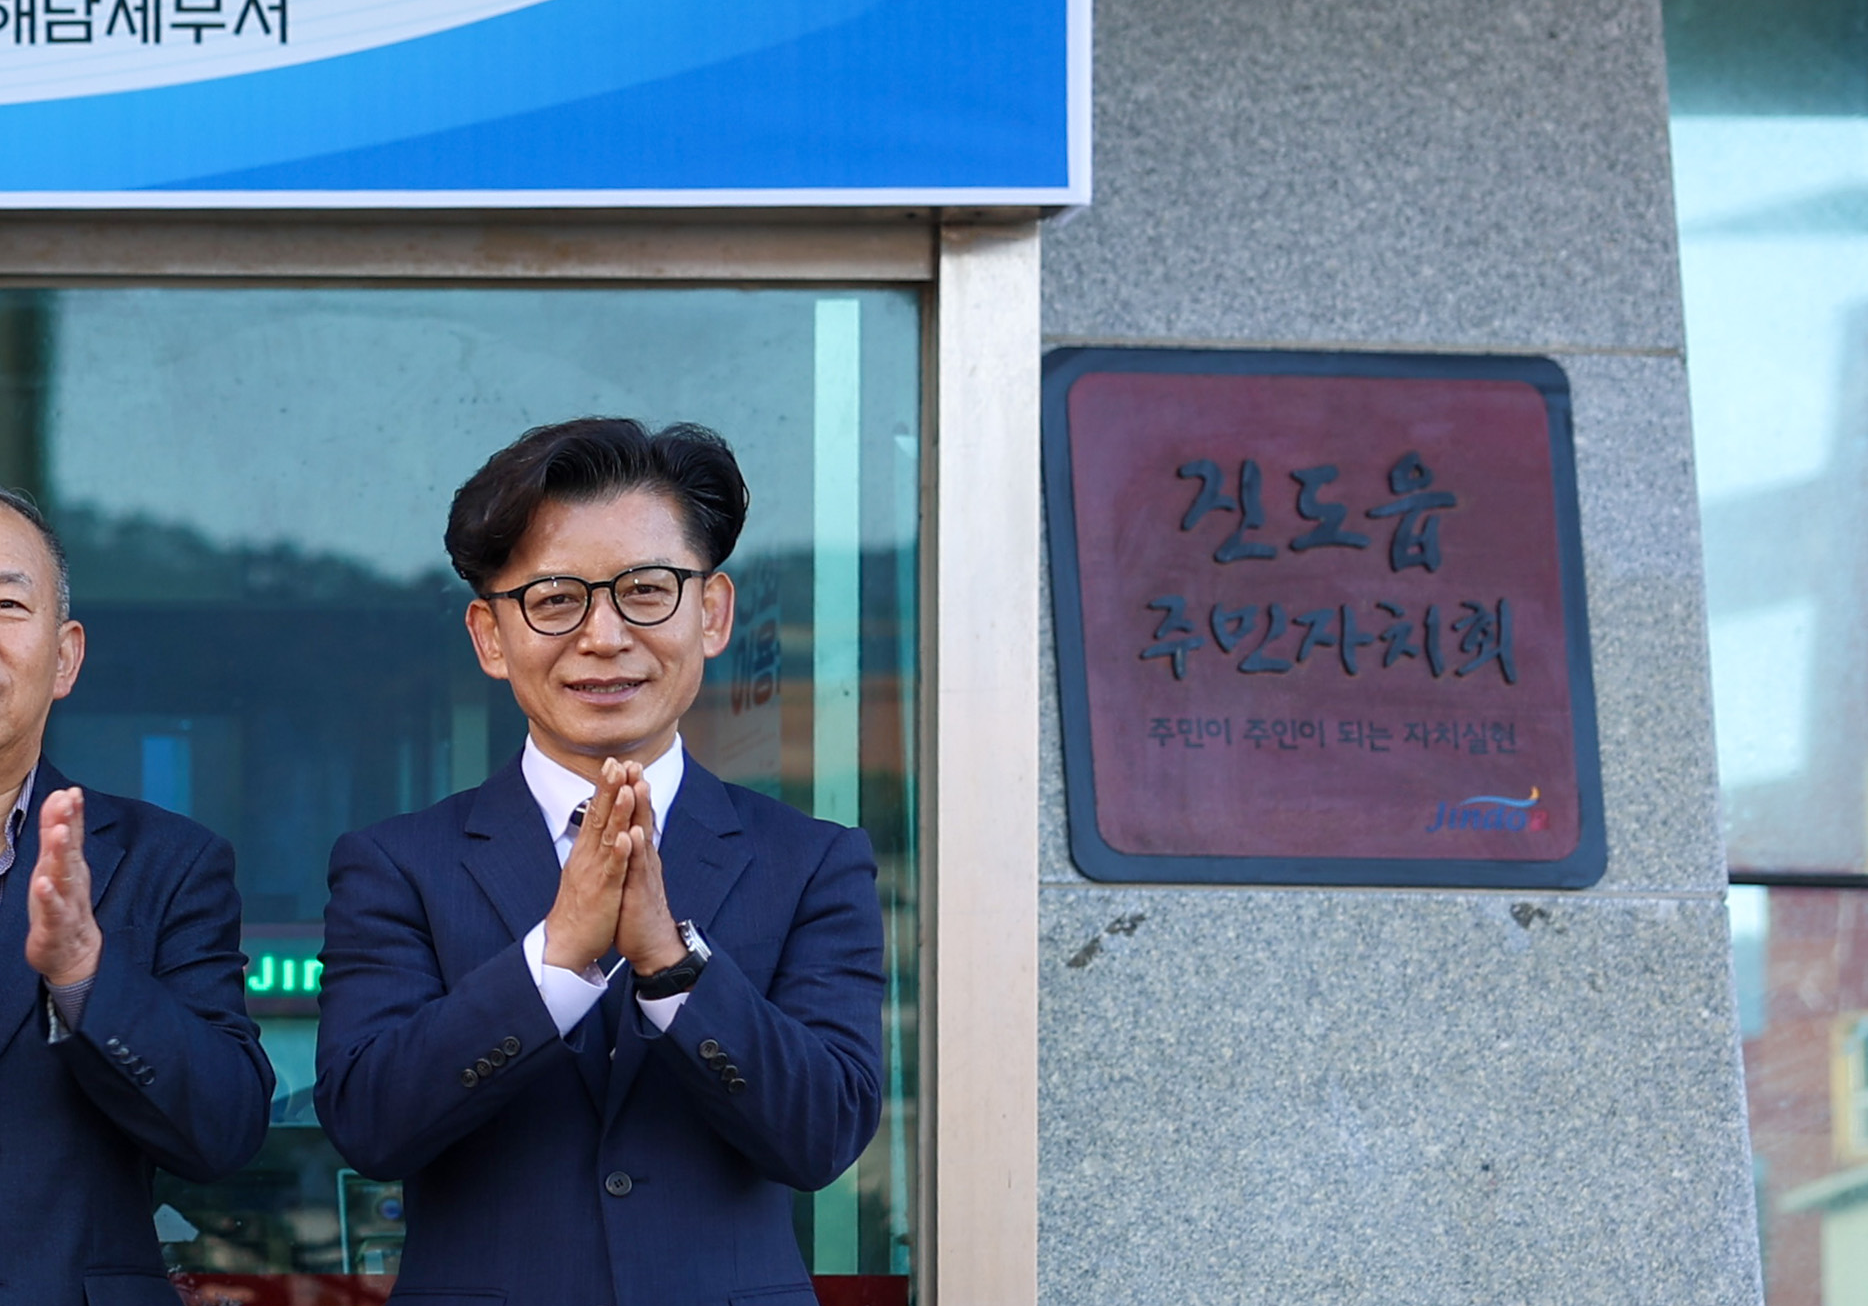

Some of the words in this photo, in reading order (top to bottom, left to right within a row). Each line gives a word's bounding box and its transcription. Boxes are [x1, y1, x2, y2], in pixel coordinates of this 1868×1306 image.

[1175, 451, 1458, 574] 진도읍
[1139, 595, 1518, 685] 주민자치회
[1148, 716, 1233, 749] 주민이
[1242, 717, 1326, 751] 주인이
[1337, 719, 1394, 752] 되는
[1403, 720, 1518, 755] 자치실현
